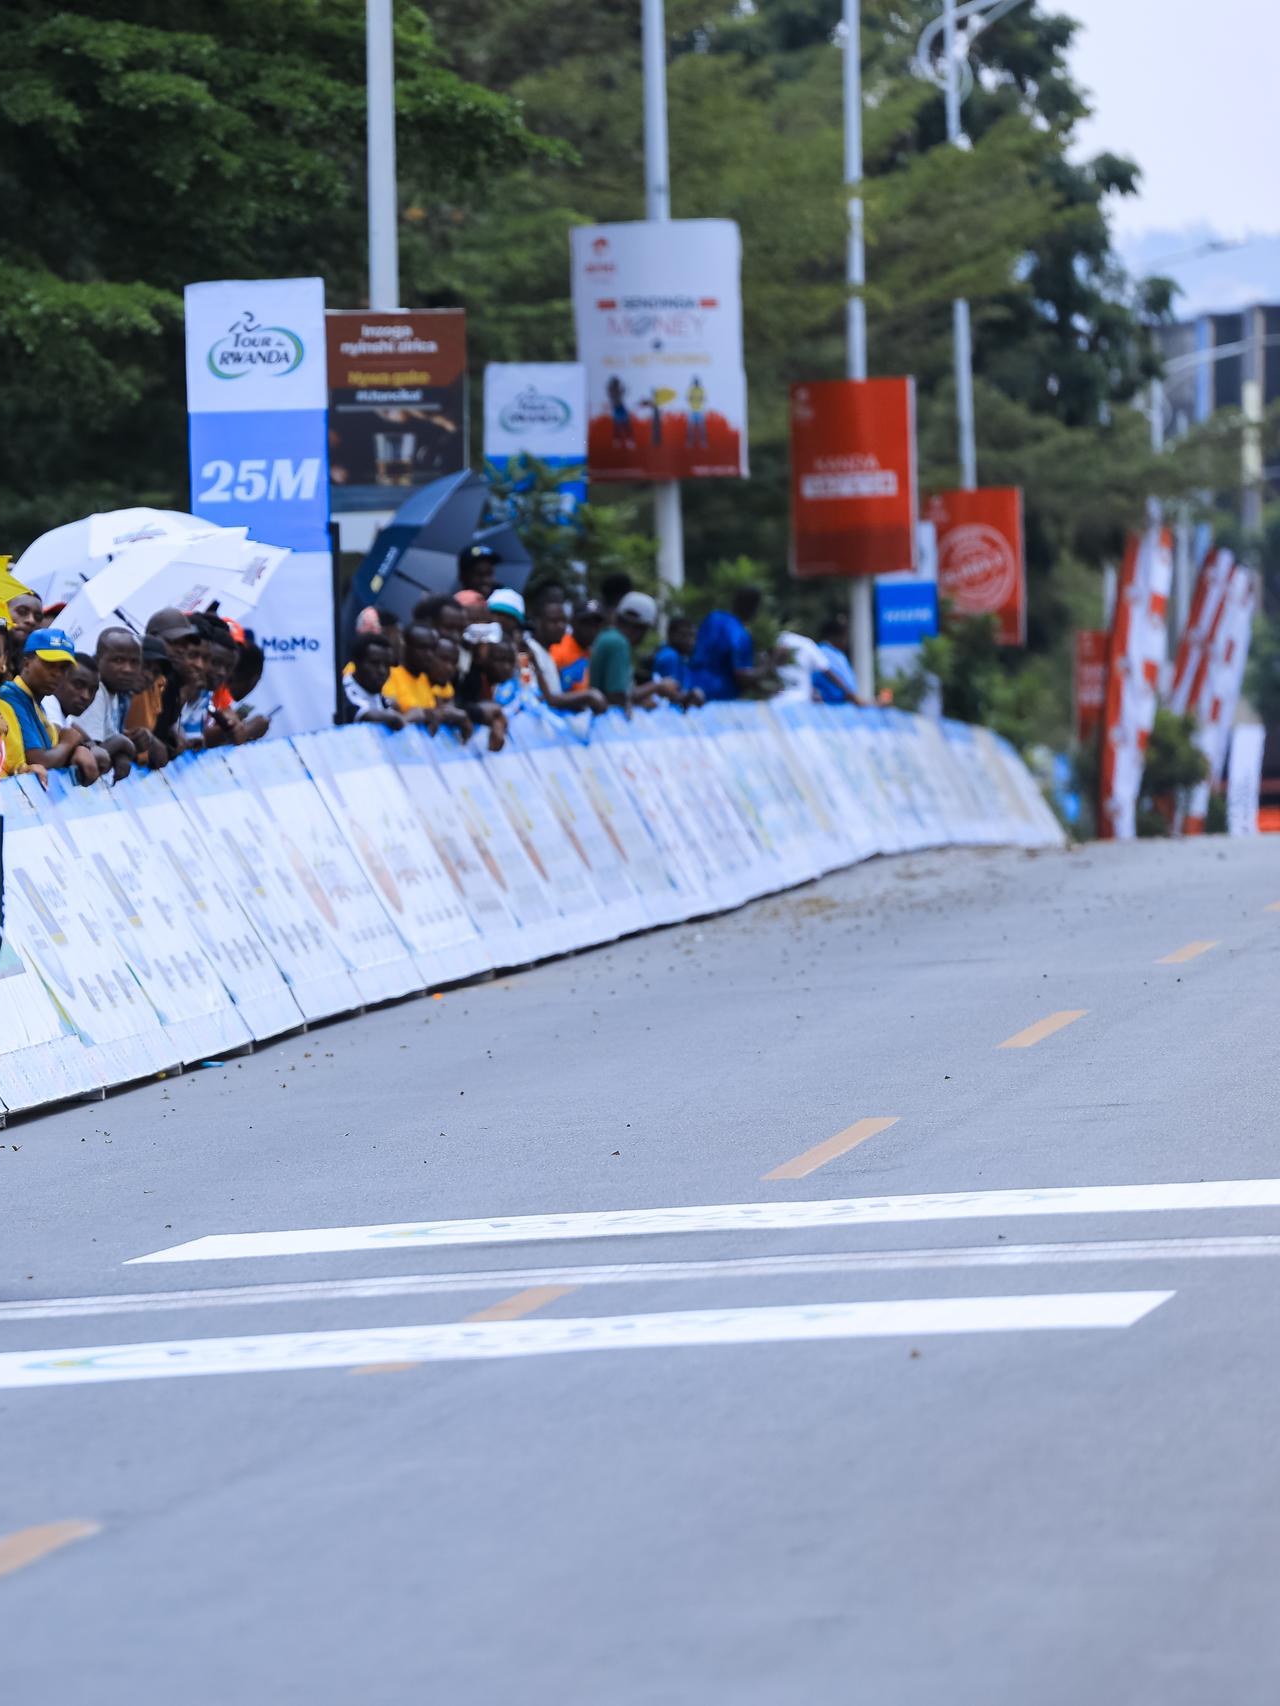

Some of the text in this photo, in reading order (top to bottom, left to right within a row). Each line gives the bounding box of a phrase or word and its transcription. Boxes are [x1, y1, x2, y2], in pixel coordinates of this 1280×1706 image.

[220, 349, 290, 366] RWANDA
[198, 458, 321, 504] 25M
[262, 635, 320, 652] MoMo
